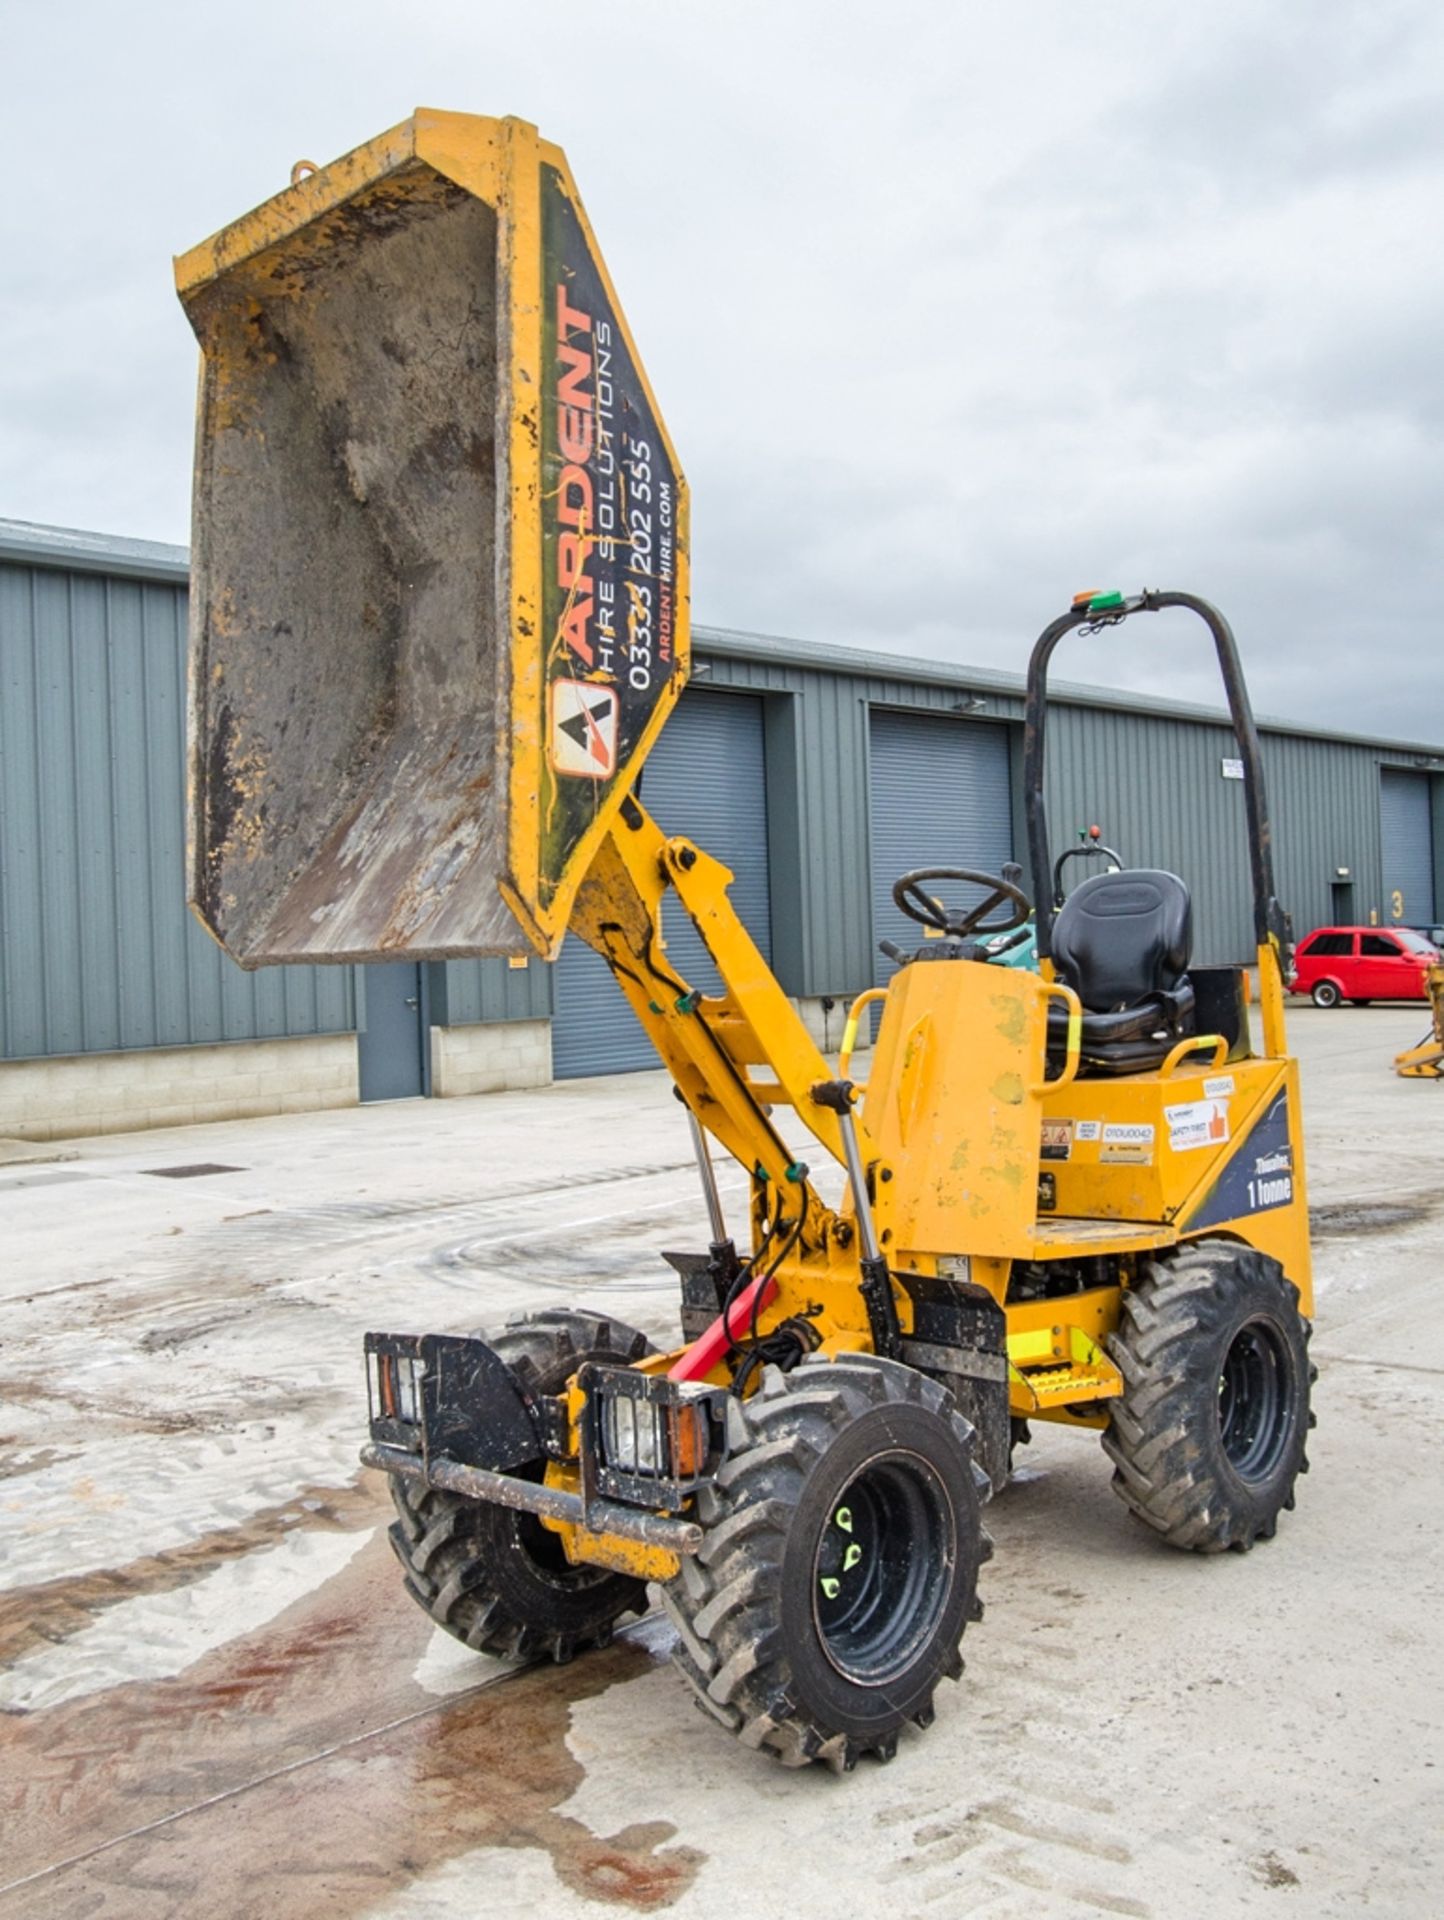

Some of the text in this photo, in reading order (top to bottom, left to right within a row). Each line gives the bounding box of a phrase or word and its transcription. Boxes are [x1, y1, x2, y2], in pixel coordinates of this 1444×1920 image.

[556, 284, 594, 667] ARDENT
[597, 320, 615, 673] HIRE SOLUTIONS
[629, 440, 651, 690] 03333 202 555
[1391, 890, 1403, 918] 3
[1247, 1177, 1291, 1209] 1 tonne
